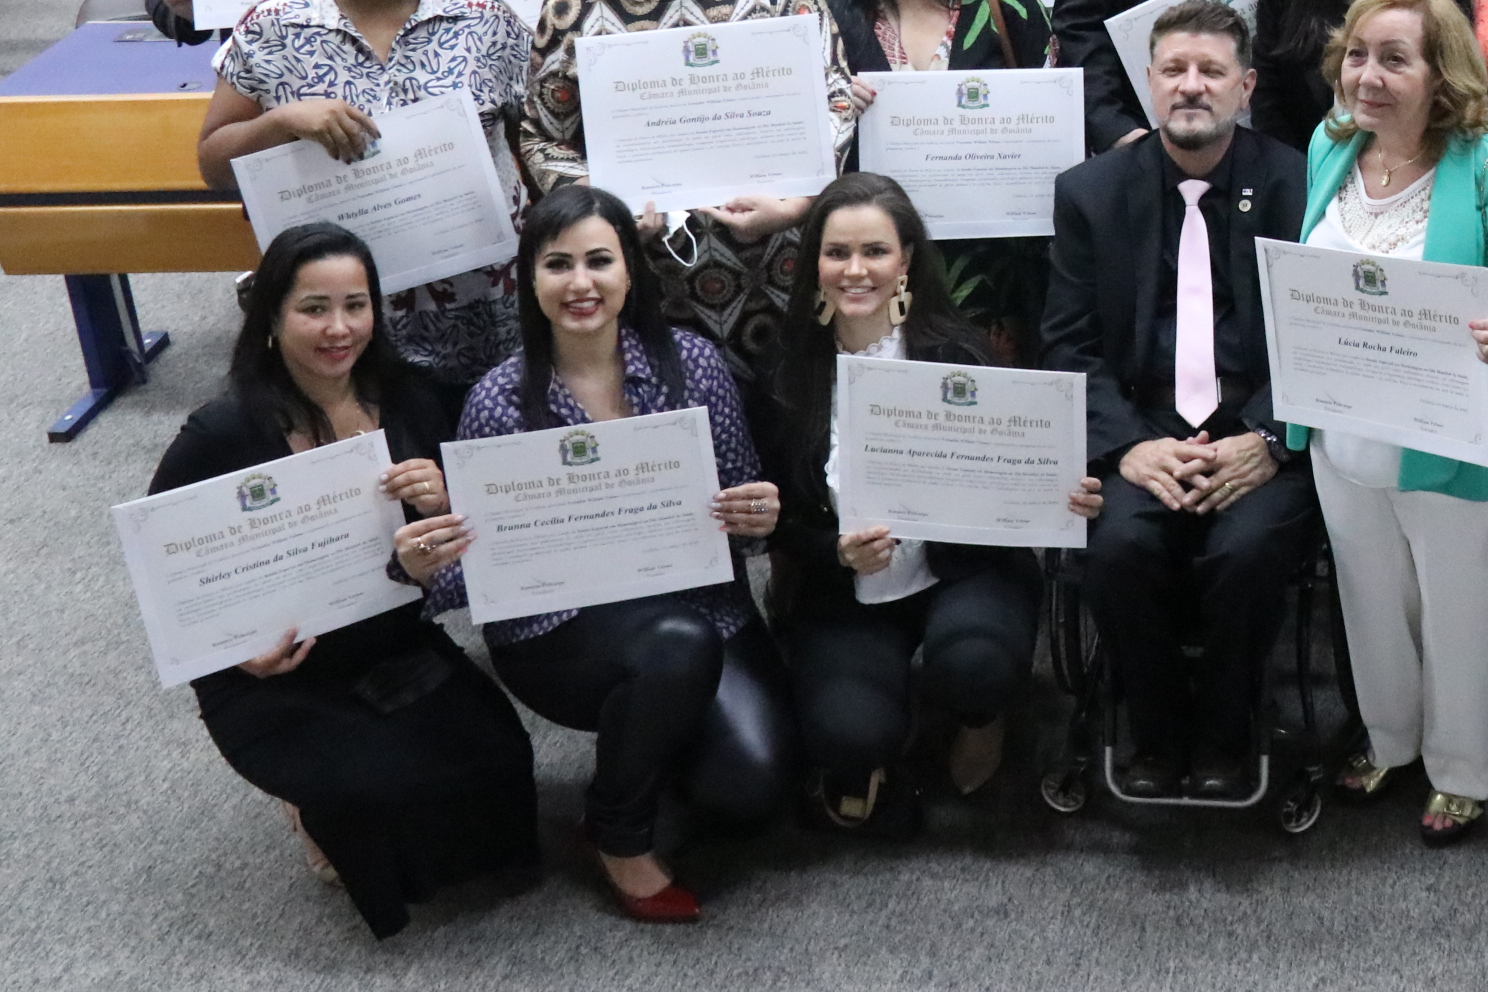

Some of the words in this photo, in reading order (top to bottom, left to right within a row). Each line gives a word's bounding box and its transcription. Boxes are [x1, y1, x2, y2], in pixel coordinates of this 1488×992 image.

[613, 79, 667, 94] Diploma
[670, 77, 684, 86] de
[688, 73, 728, 85] Honra
[732, 72, 746, 81] ao
[750, 66, 792, 80] Mérito
[890, 116, 939, 130] Diploma
[942, 116, 954, 125] de
[959, 114, 995, 125] Honra
[999, 116, 1012, 124] ao
[1016, 113, 1055, 125] Mérito
[277, 179, 334, 202] Diploma
[334, 174, 348, 184] de
[351, 161, 393, 179] Honra
[395, 156, 409, 167] ao
[413, 142, 454, 163] Mérito
[1290, 288, 1338, 308] Diploma
[1342, 297, 1354, 309] de
[1358, 298, 1396, 316] Honra
[1400, 308, 1414, 318] ao
[1418, 308, 1459, 325] Mérito
[869, 404, 922, 421] Diploma
[926, 410, 939, 420] de
[944, 410, 984, 424] Honra
[988, 417, 1002, 425] ao
[1007, 415, 1051, 428] Mérito
[484, 480, 544, 495] Diploma
[547, 476, 561, 486] de
[566, 470, 610, 484] Honra
[614, 468, 629, 477] ao
[634, 460, 680, 476] Mérito
[163, 531, 225, 556] Diploma
[227, 525, 242, 536] de
[247, 509, 292, 530] Honra
[296, 503, 312, 515] ao
[316, 488, 361, 510] Mérito
